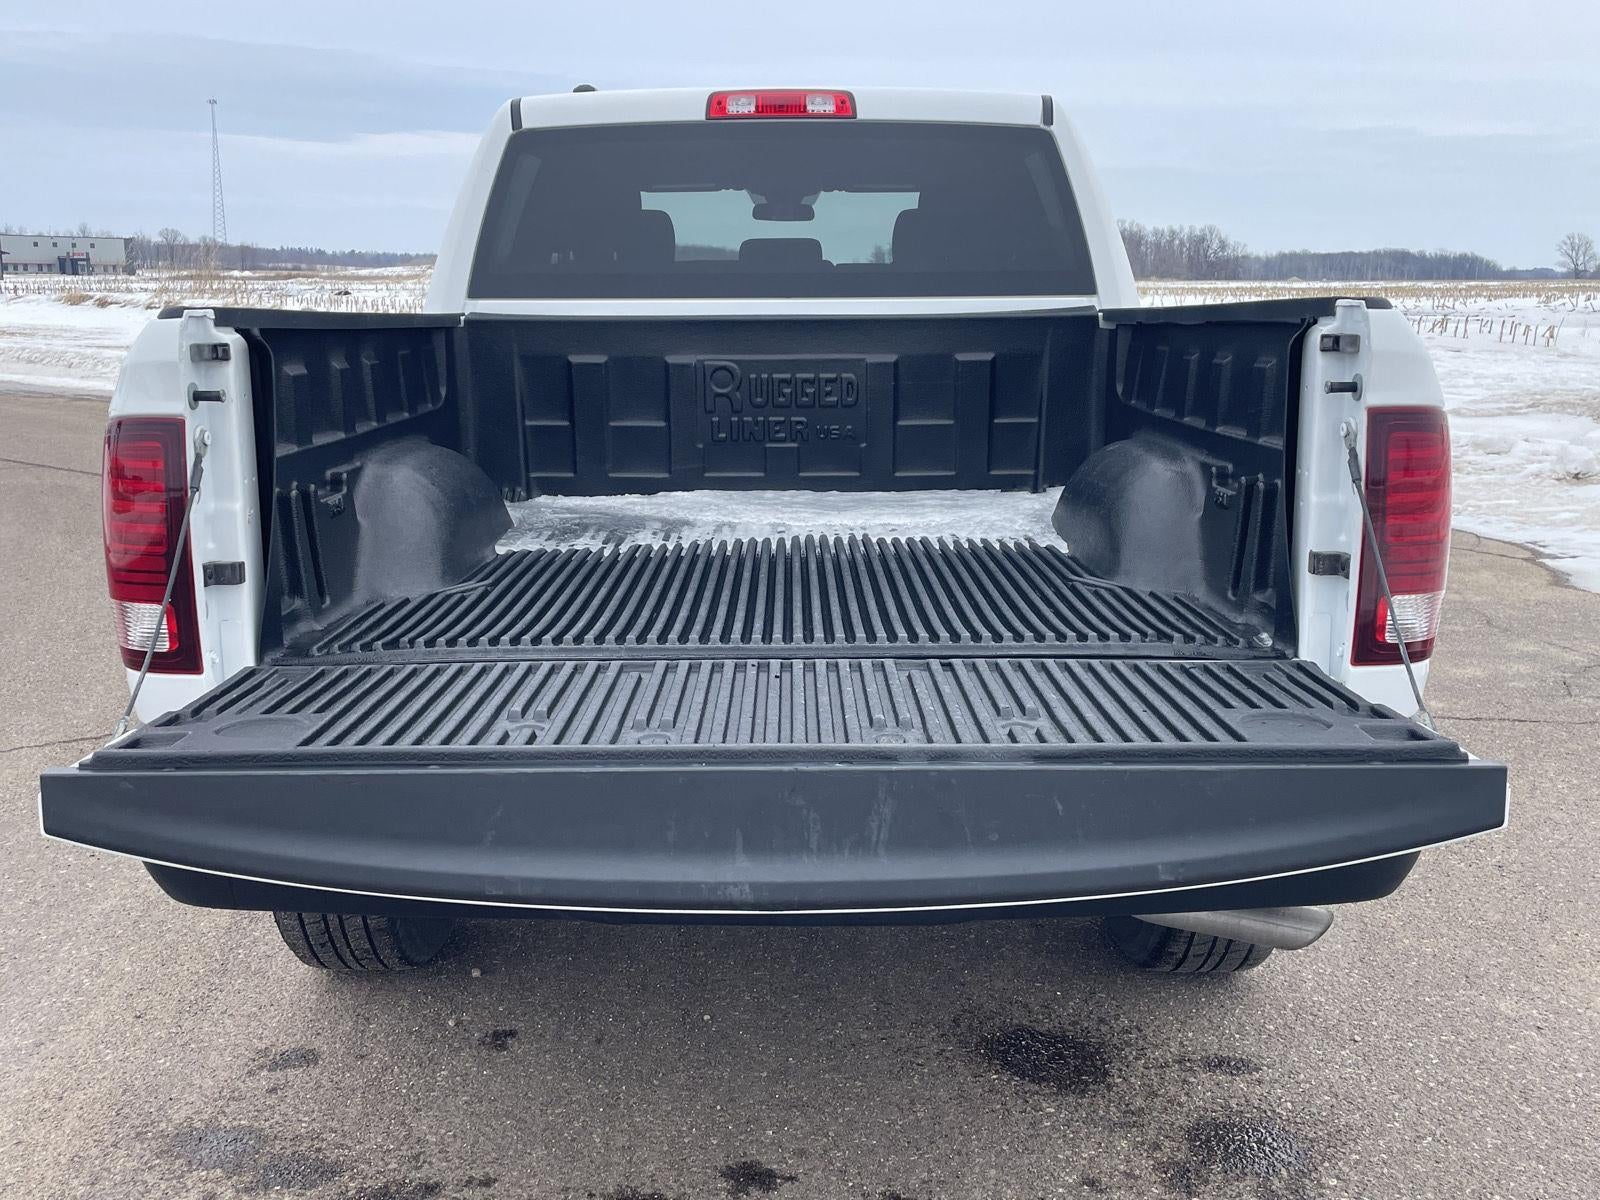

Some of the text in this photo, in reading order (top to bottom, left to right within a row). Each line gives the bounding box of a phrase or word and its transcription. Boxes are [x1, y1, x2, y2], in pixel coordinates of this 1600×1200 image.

[703, 360, 859, 413] RUGGED
[711, 416, 856, 442] LINER USA
